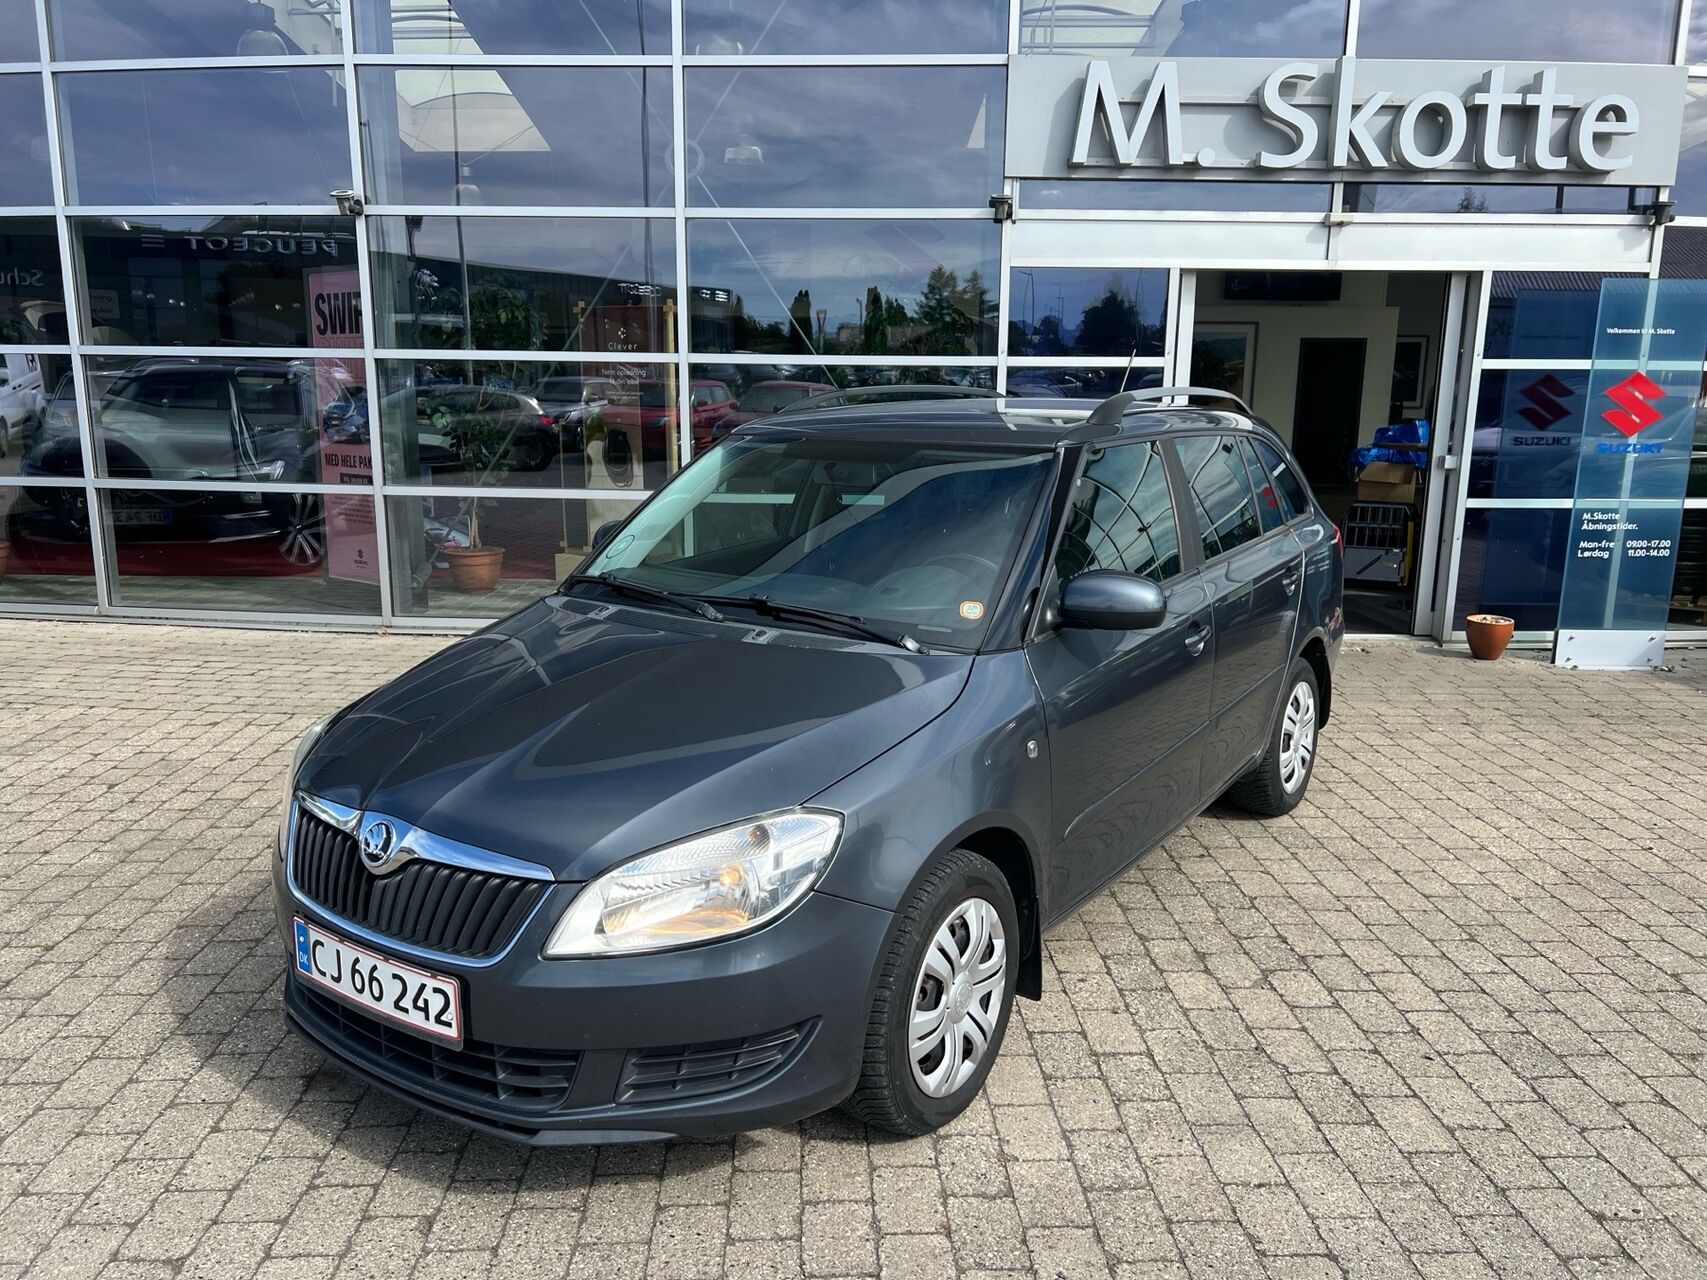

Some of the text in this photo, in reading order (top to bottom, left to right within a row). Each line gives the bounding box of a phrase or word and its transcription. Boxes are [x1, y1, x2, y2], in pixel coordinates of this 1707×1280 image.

[1071, 60, 1641, 172] M. Skotte
[1606, 327, 1641, 335] Velkommen
[608, 342, 638, 350] Clever
[1512, 436, 1571, 447] SUZUKI
[1596, 441, 1664, 455] SUZUKI
[324, 453, 340, 467] MED
[340, 454, 358, 468] HELE
[1582, 511, 1621, 521] M.Skotte
[1581, 520, 1639, 532] Åbningstider.
[1579, 539, 1671, 549] Man-fre 09.00-17.00
[1577, 549, 1670, 559] Lørdag 11.00-14.00
[299, 951, 309, 966] DK
[311, 938, 454, 1028] CJ 66 242
